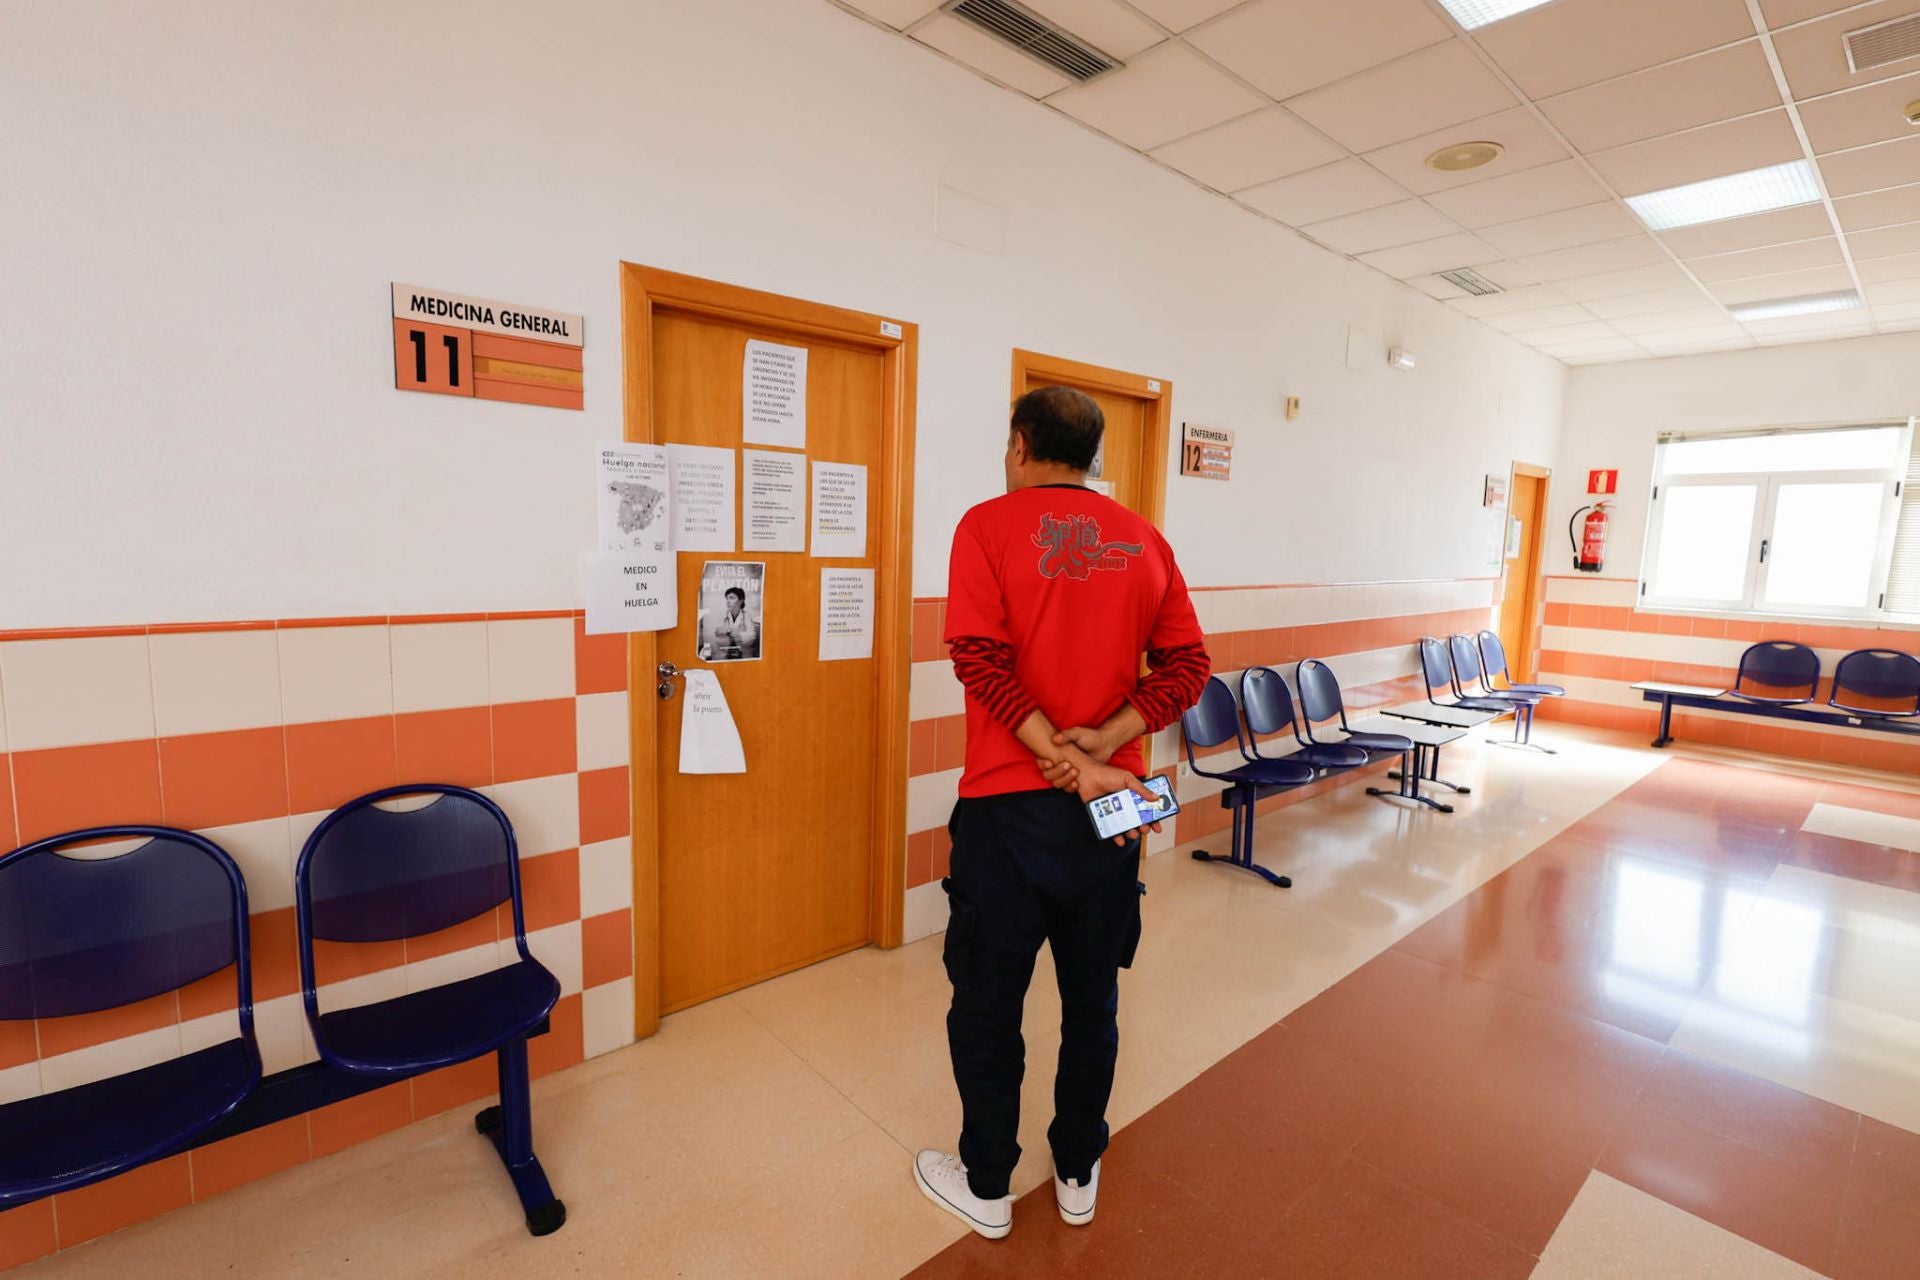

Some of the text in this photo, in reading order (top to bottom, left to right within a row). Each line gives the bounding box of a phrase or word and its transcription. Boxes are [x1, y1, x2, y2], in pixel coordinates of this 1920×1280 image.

[411, 294, 569, 337] MEDICINA GENERAL
[410, 330, 459, 387] 11
[1190, 427, 1228, 442] ENFERMERIA
[602, 458, 666, 469] Huelga naciona
[1186, 444, 1200, 472] 12
[623, 565, 657, 575] MEDICO
[715, 565, 745, 577] EVITA EL
[636, 582, 647, 591] EN
[624, 597, 658, 607] HUELGA
